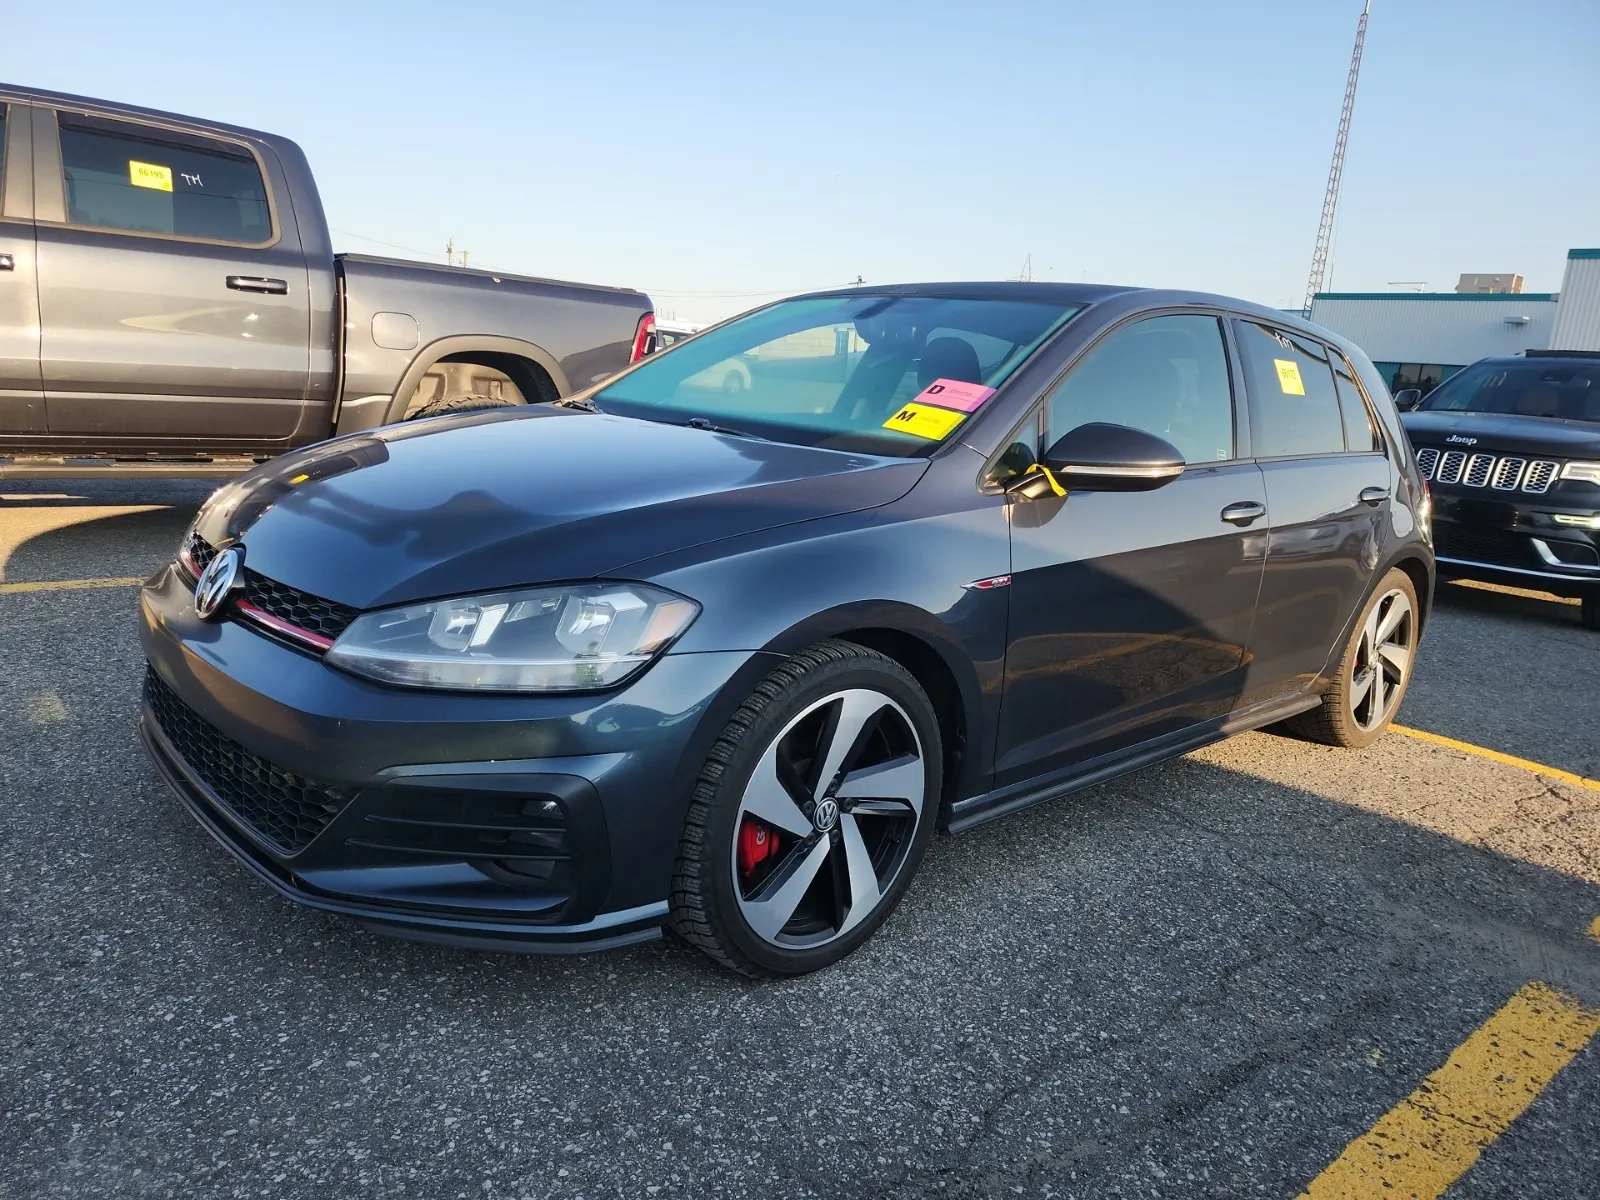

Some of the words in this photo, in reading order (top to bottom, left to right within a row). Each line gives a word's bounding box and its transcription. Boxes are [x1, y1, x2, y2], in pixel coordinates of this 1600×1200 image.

[138, 167, 165, 180] 66195
[926, 384, 946, 395] D
[895, 410, 917, 422] M
[1446, 434, 1478, 446] Jeep
